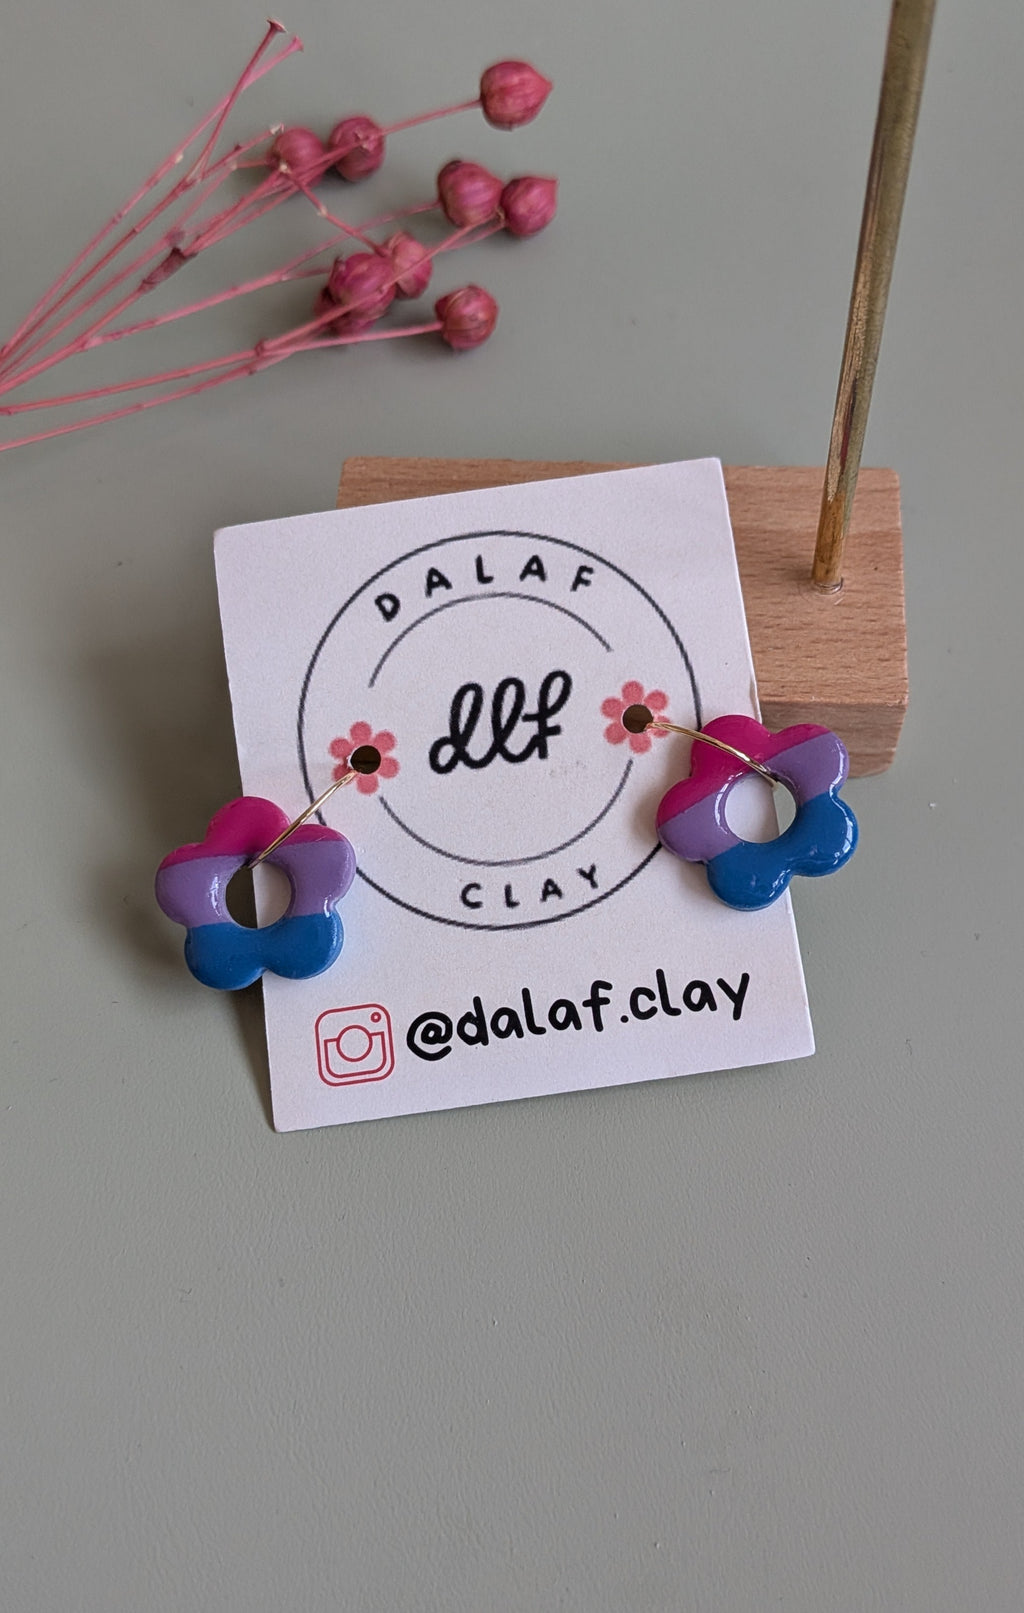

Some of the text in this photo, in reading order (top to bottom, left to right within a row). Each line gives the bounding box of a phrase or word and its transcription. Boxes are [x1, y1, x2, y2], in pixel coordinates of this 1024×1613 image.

[374, 554, 595, 622] DALAF
[460, 864, 600, 910] CLAY
[405, 968, 750, 1062] @dalaf.clay
